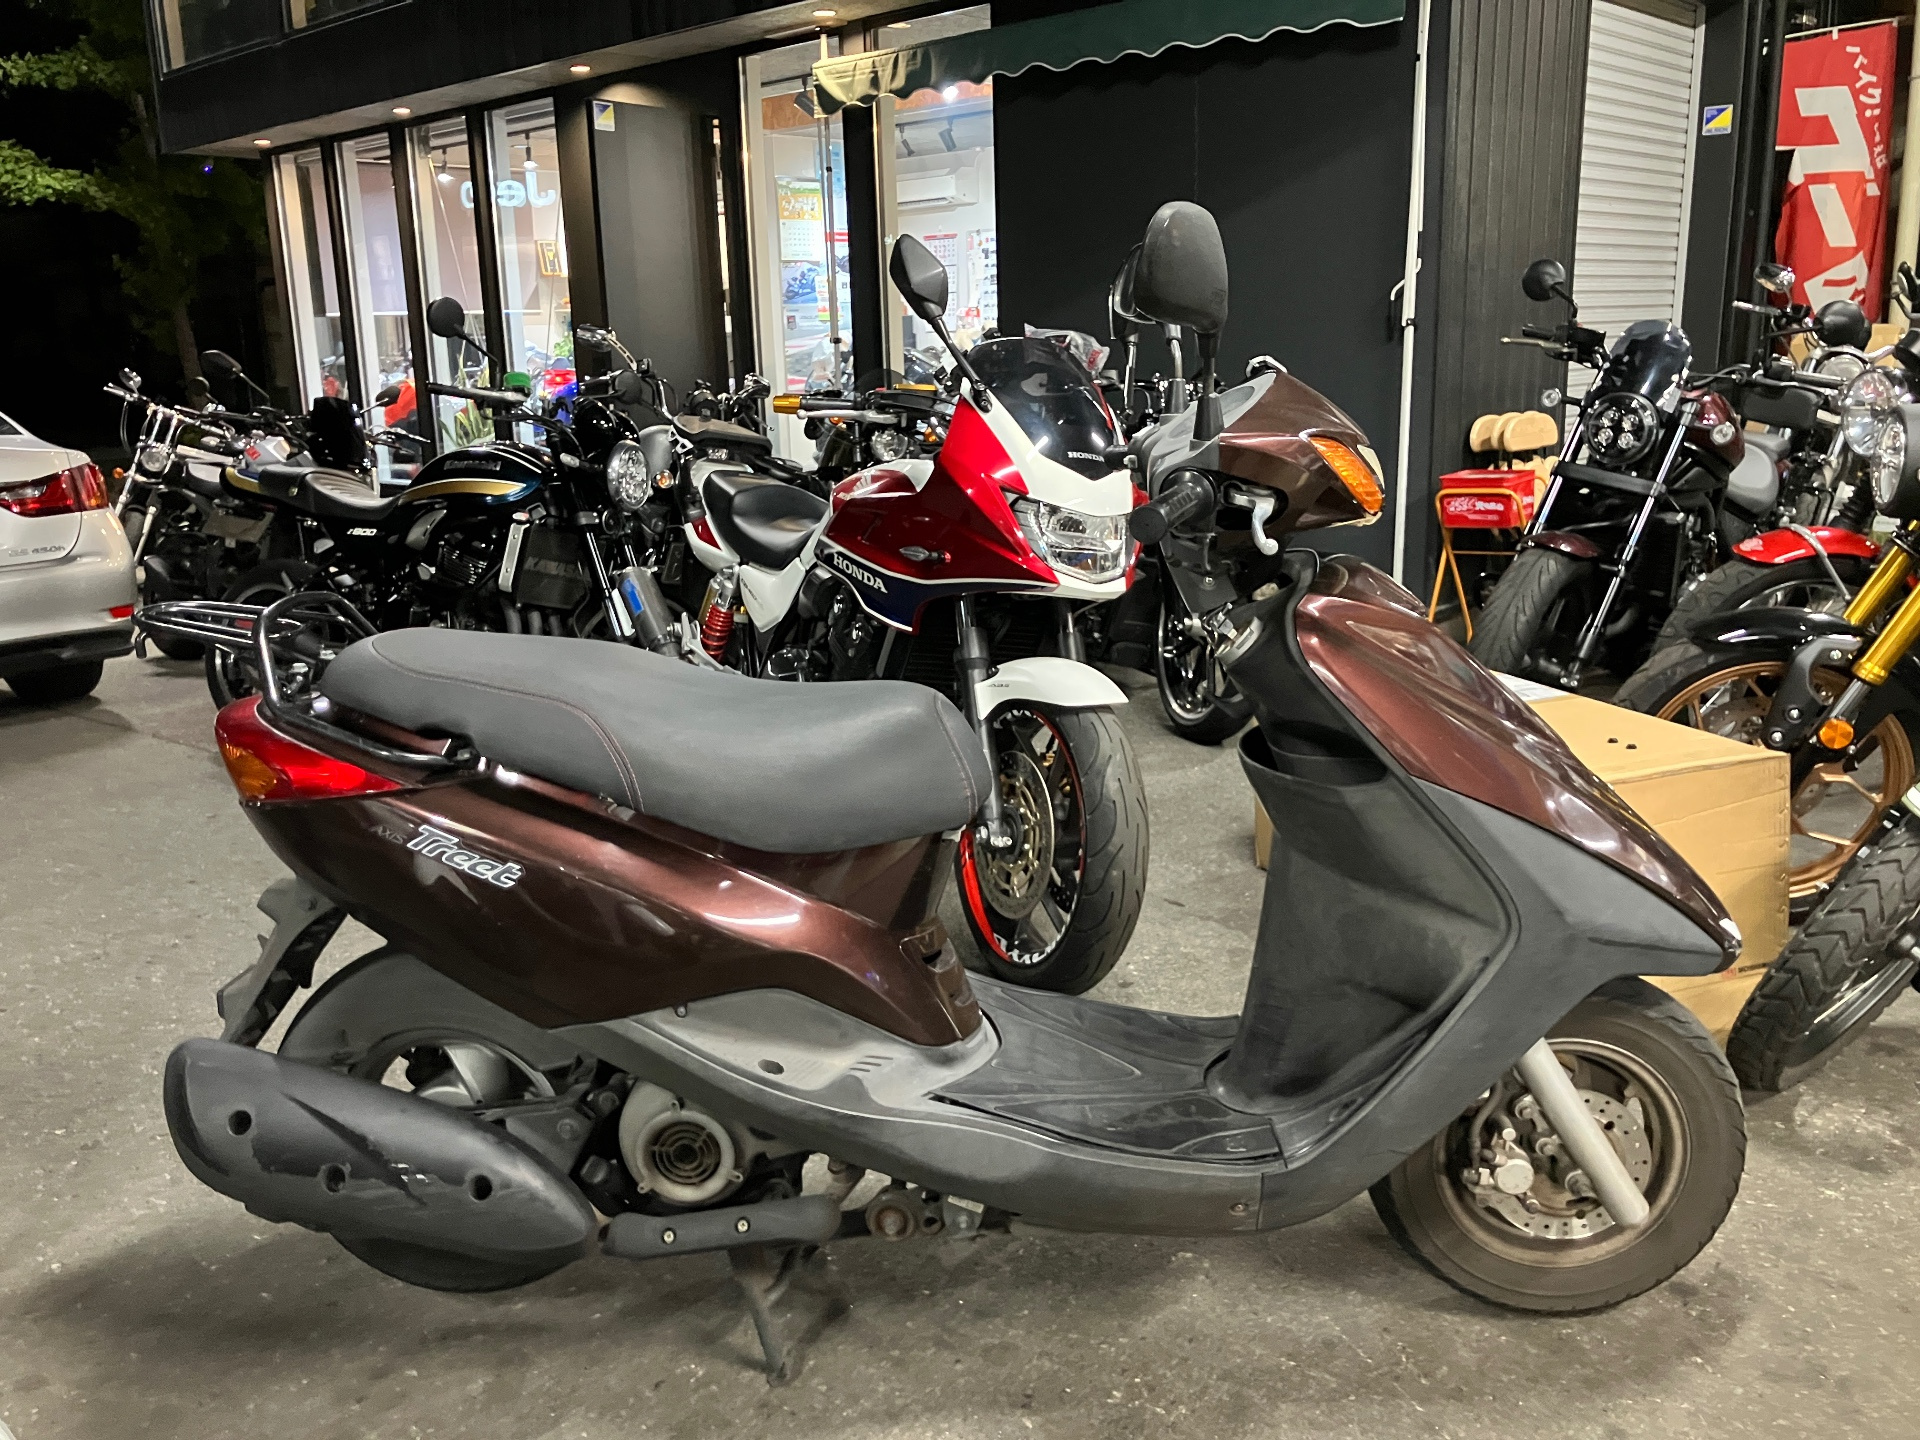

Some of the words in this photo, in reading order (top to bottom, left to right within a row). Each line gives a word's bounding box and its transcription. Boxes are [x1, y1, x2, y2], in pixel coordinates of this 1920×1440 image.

[1067, 451, 1105, 463] HONDA
[833, 552, 888, 594] HONDA
[372, 825, 407, 844] AXIS
[407, 824, 523, 888] Treet
